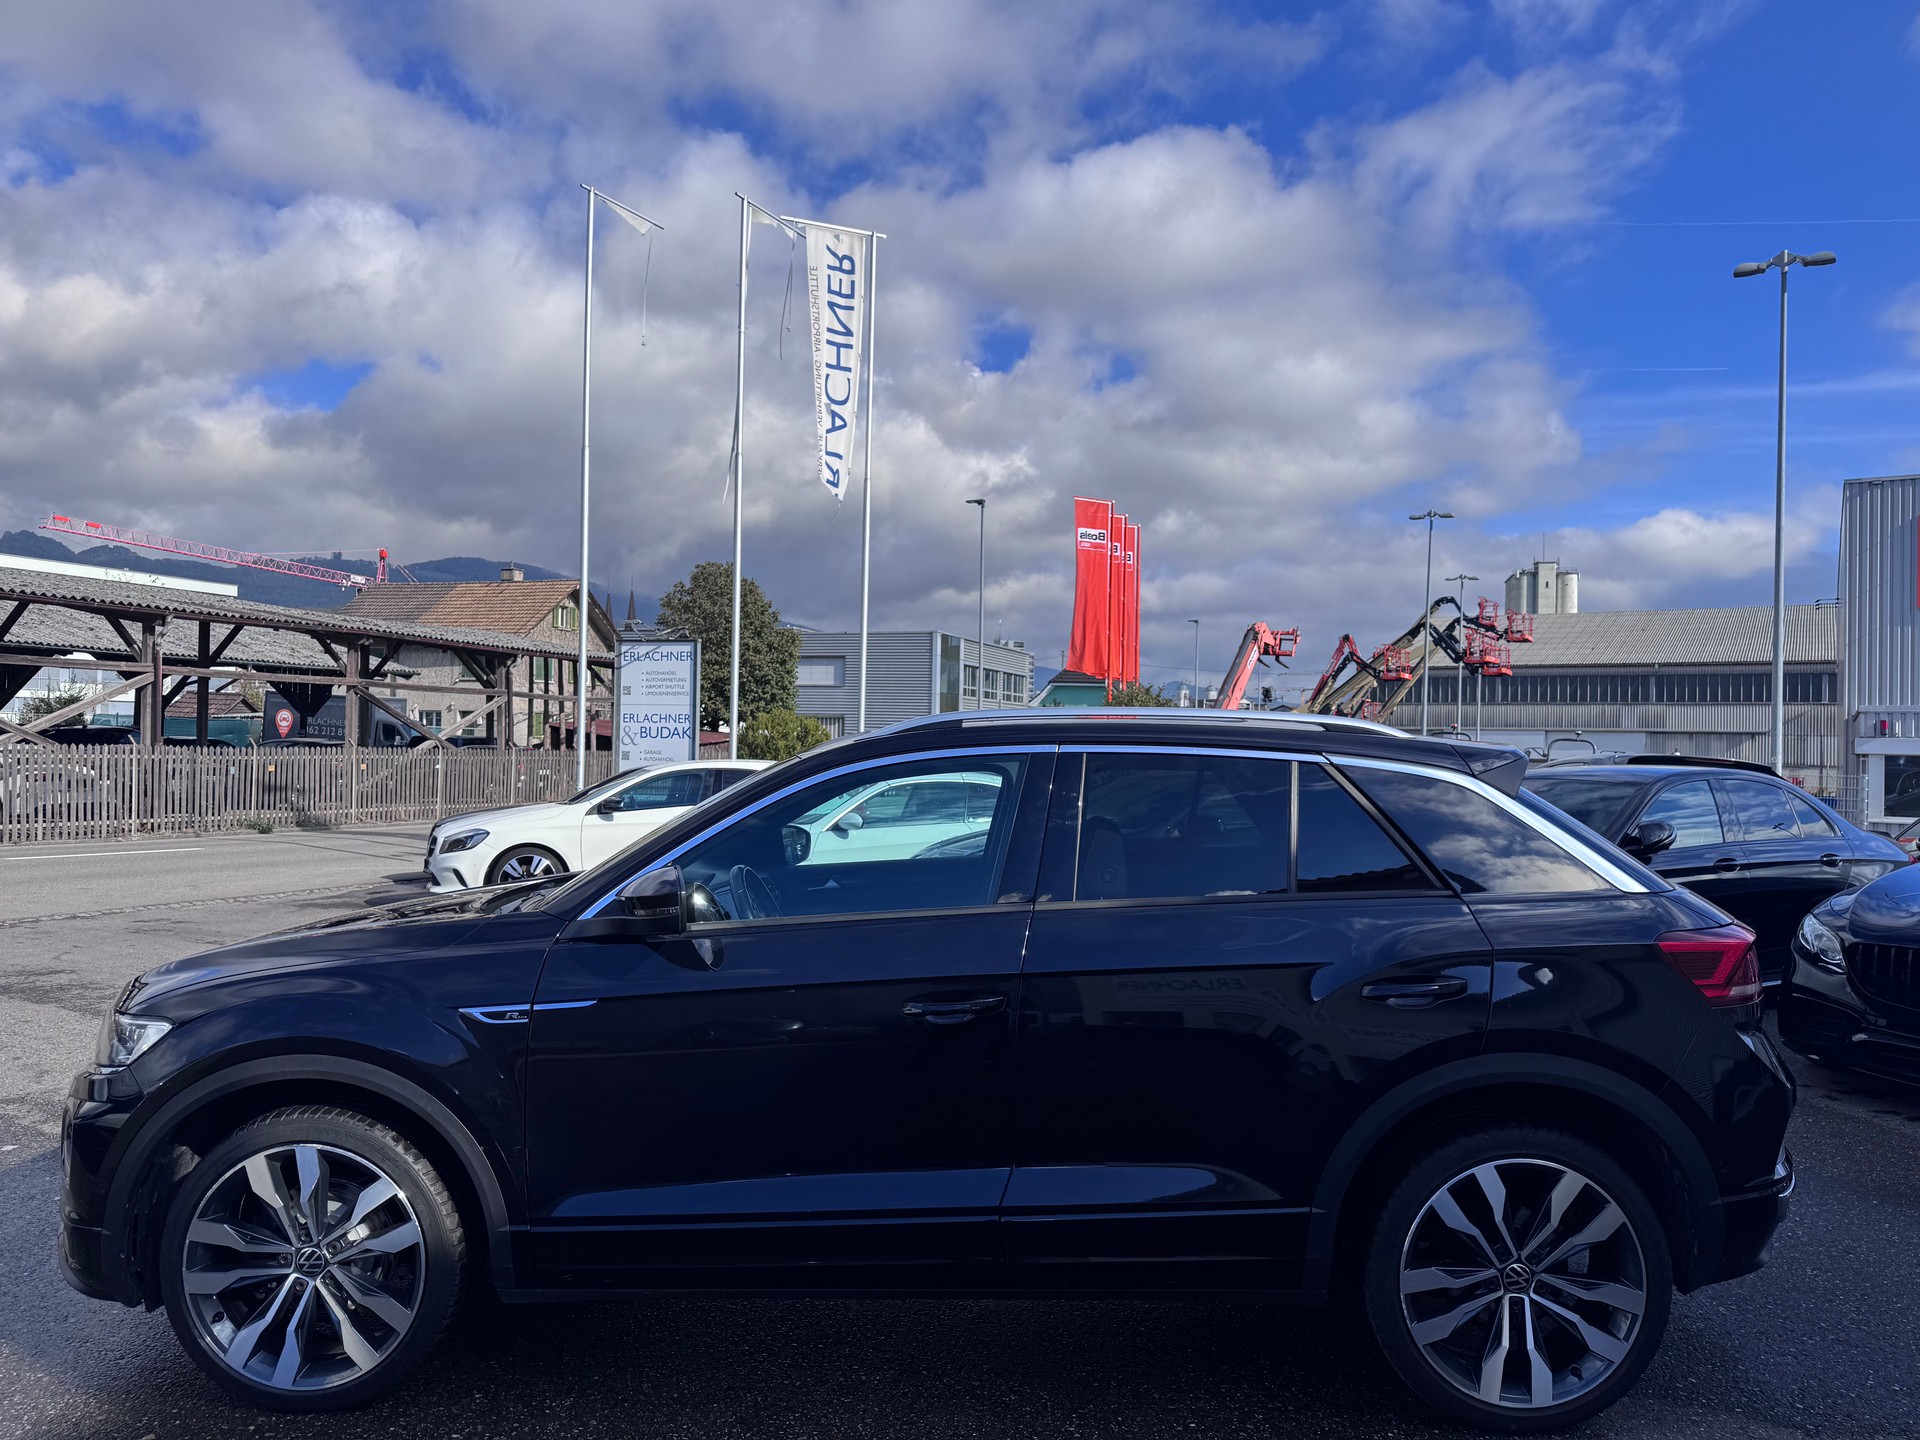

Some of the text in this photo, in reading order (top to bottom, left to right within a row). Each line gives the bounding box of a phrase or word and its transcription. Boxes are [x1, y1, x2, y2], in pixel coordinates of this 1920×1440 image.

[623, 651, 693, 661] ERLACHNER
[623, 714, 691, 724] ERLACHNER
[321, 727, 336, 736] 212
[640, 727, 691, 739] BUDAK
